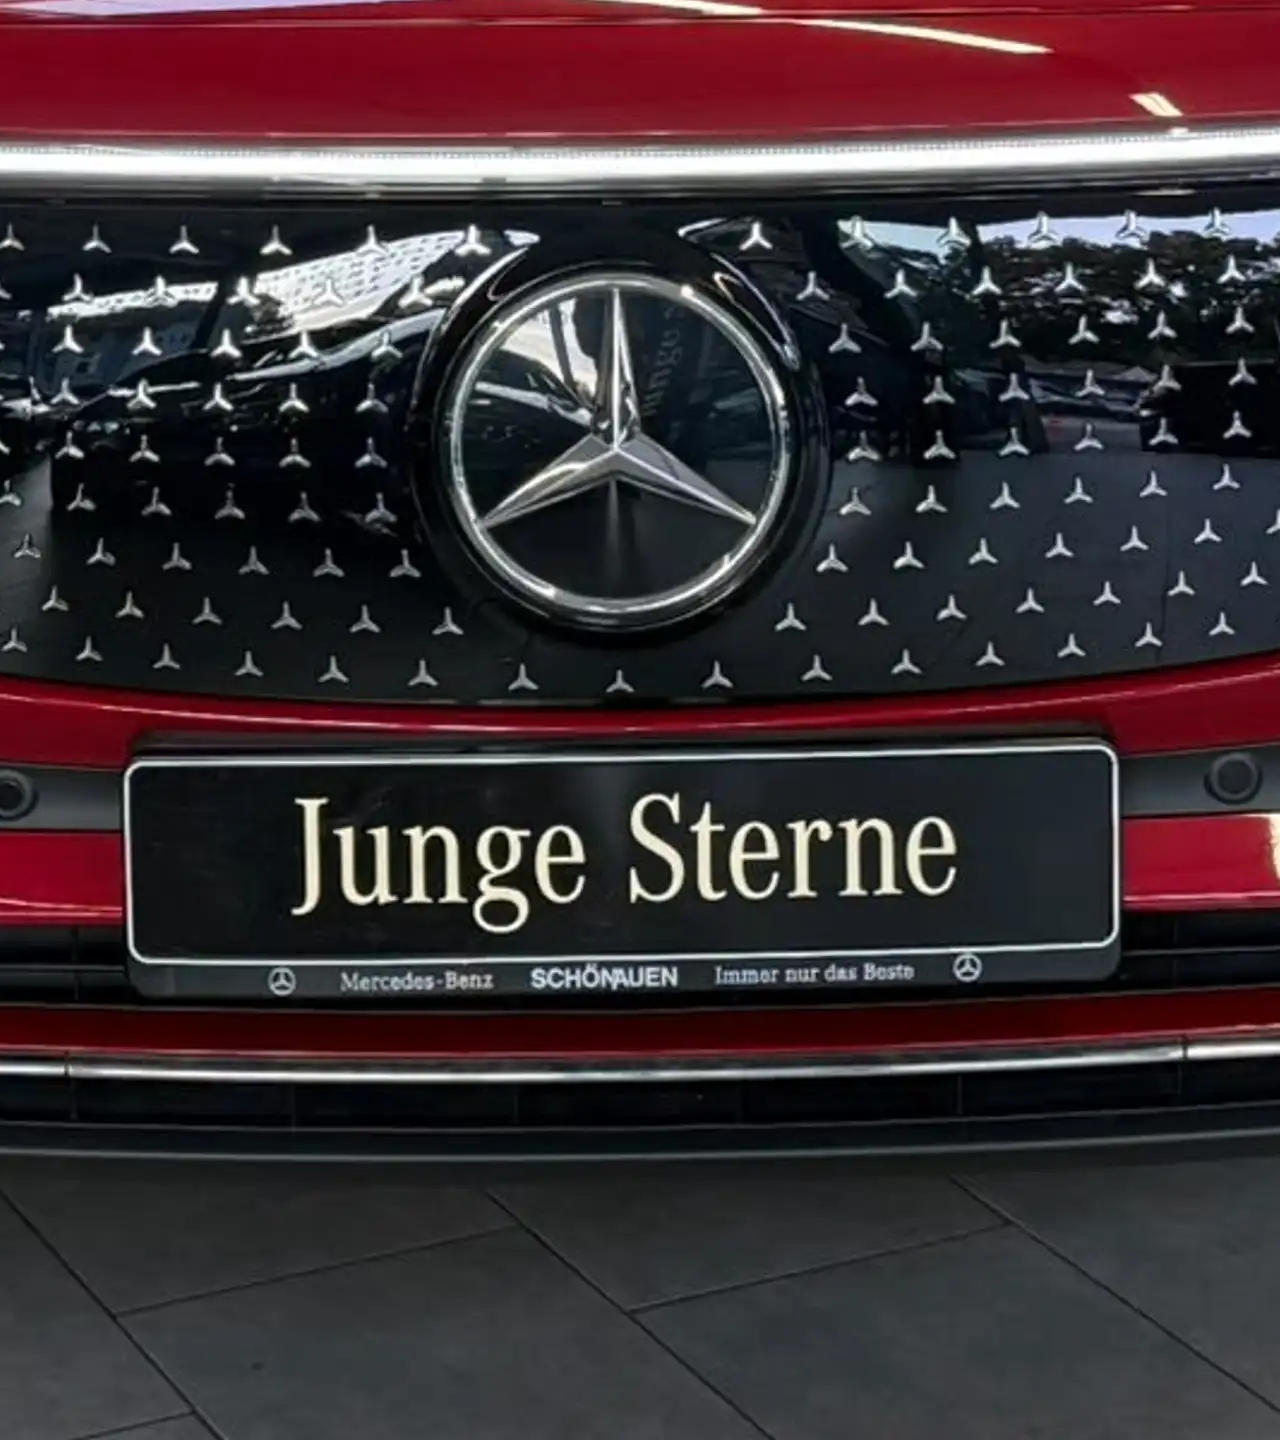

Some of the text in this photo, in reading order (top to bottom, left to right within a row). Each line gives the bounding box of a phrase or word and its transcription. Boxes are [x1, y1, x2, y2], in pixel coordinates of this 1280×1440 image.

[291, 791, 958, 934] Junge Sterne
[340, 962, 916, 991] Mercedes-Benz SCHÖNAUEN Immer nur das Beste
